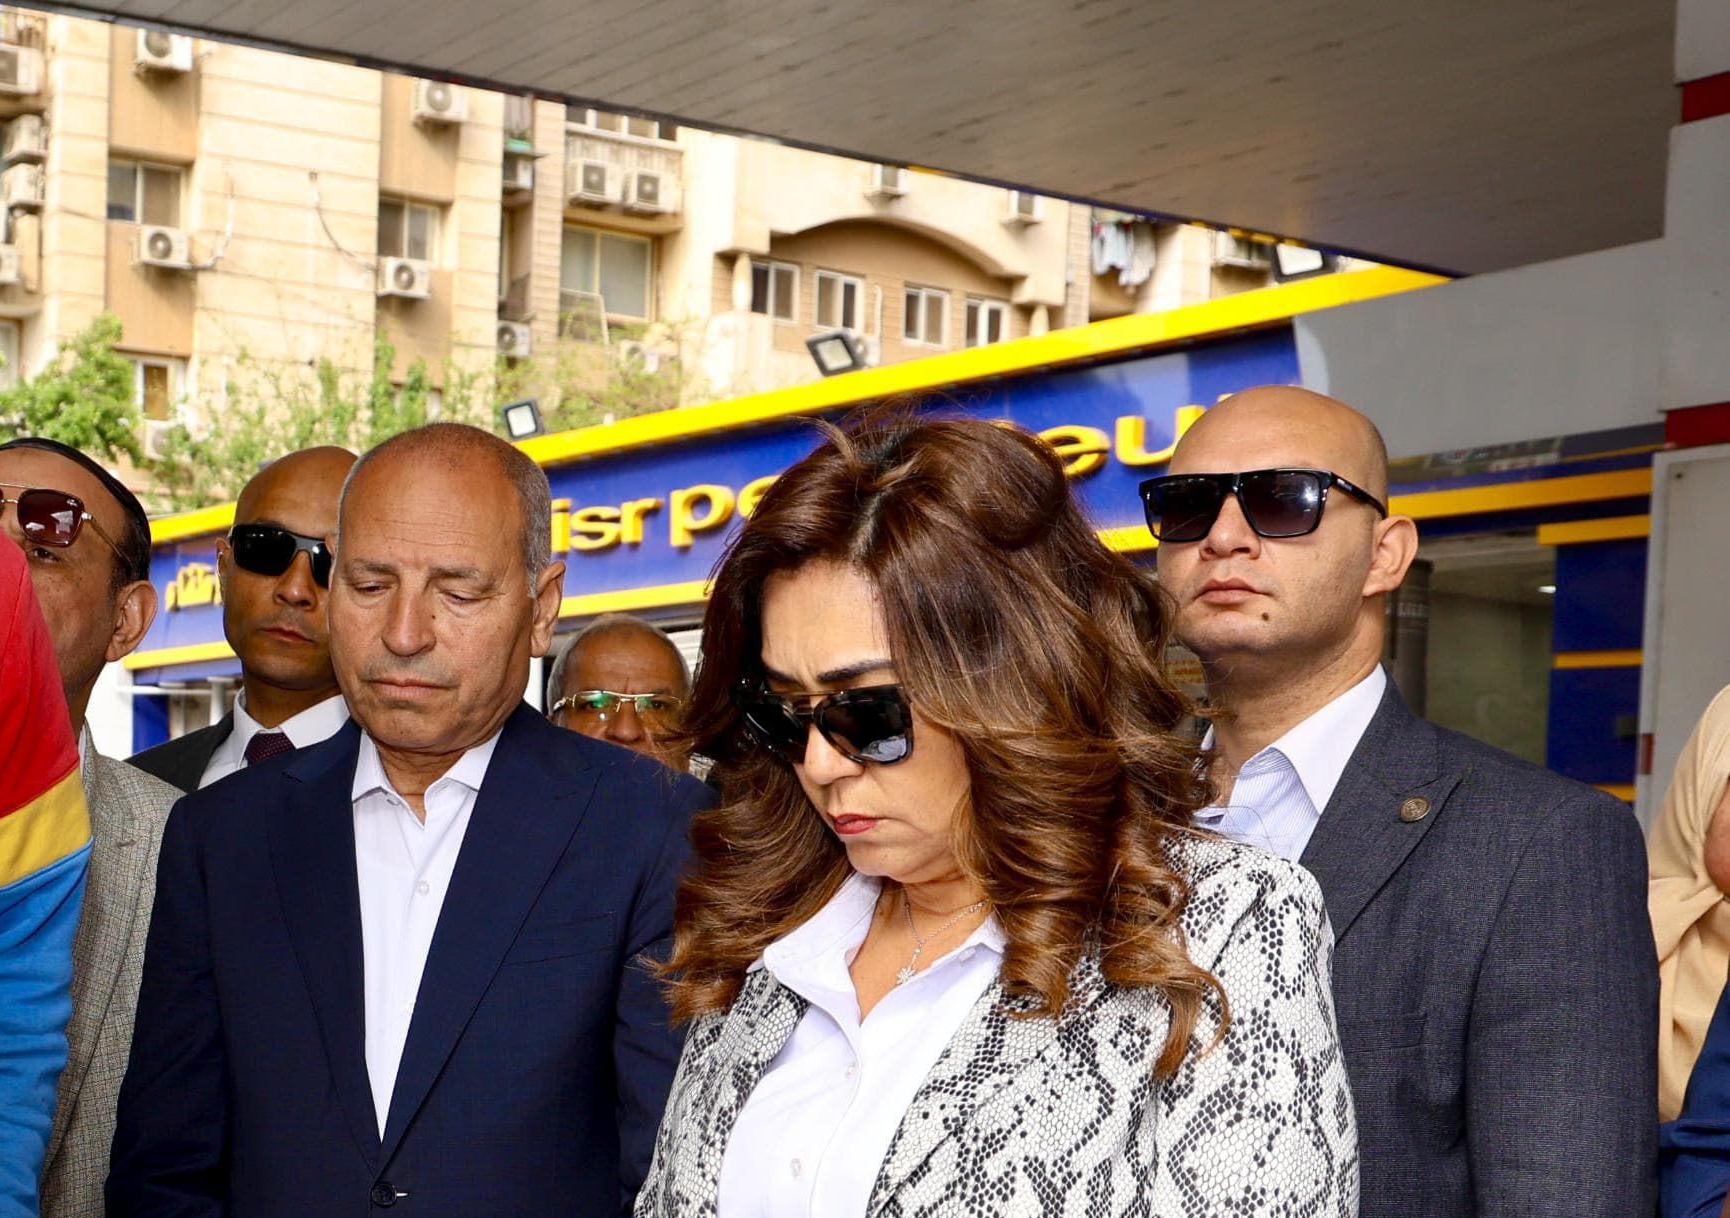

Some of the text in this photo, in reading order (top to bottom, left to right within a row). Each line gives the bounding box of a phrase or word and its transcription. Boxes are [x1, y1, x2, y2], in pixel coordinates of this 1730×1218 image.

[551, 405, 1208, 553] isr pe eu
